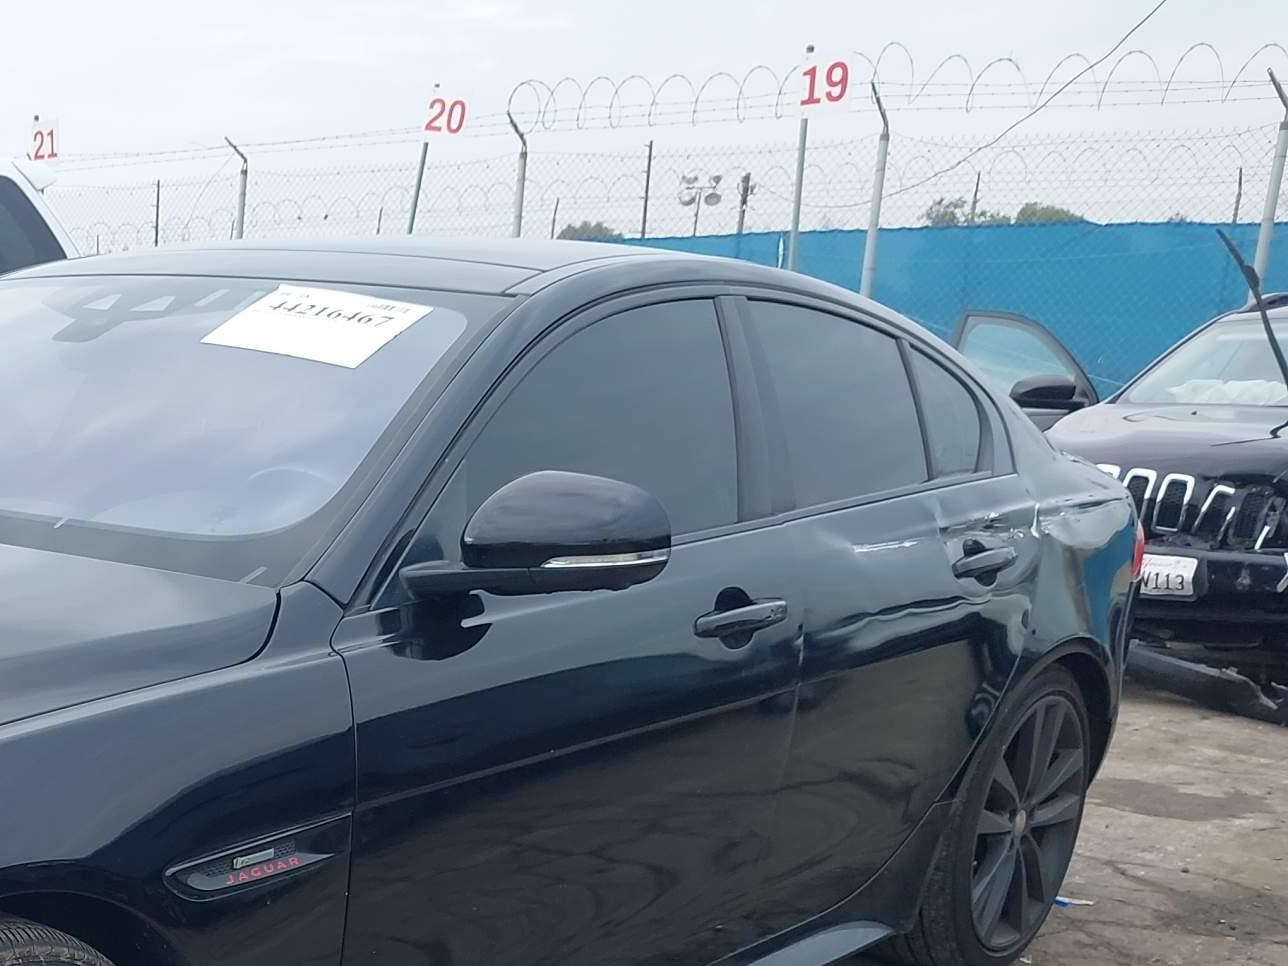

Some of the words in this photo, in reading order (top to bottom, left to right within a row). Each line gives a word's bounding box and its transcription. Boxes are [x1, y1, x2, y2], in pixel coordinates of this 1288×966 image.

[800, 60, 849, 106] 19
[424, 98, 466, 134] 20
[33, 128, 57, 160] 21
[268, 299, 396, 328] 44216467
[225, 856, 301, 886] JAGUAR
